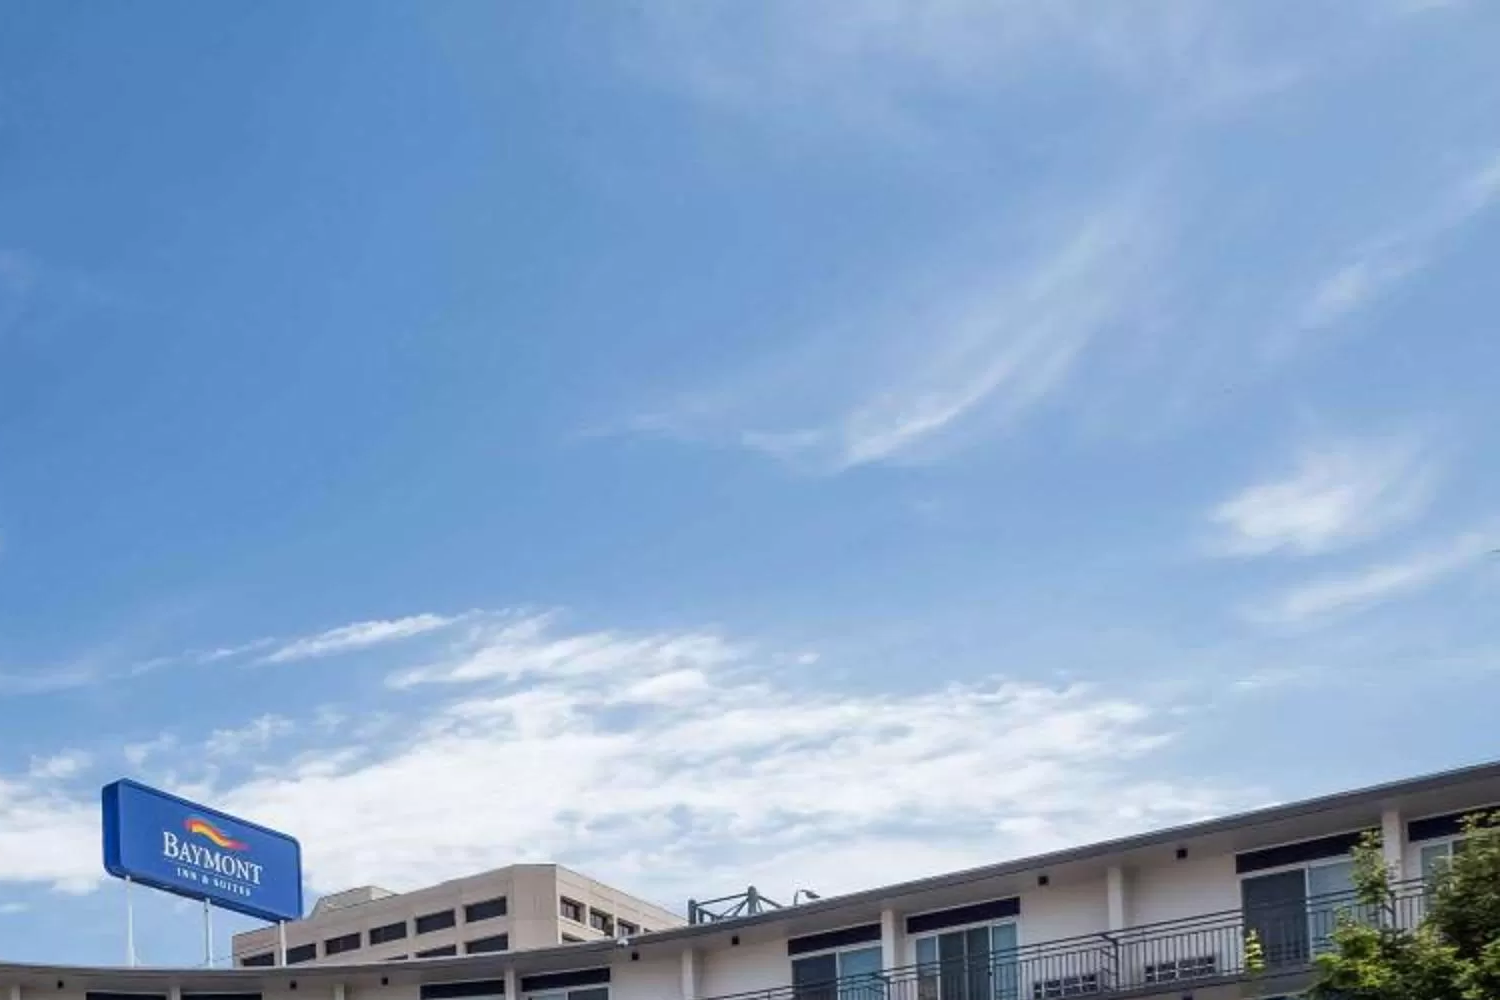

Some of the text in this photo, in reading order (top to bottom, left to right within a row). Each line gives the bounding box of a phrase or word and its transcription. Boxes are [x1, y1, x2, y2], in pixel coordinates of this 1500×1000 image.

[163, 831, 263, 885] BAYMONT
[176, 867, 251, 897] INN & SUITES
